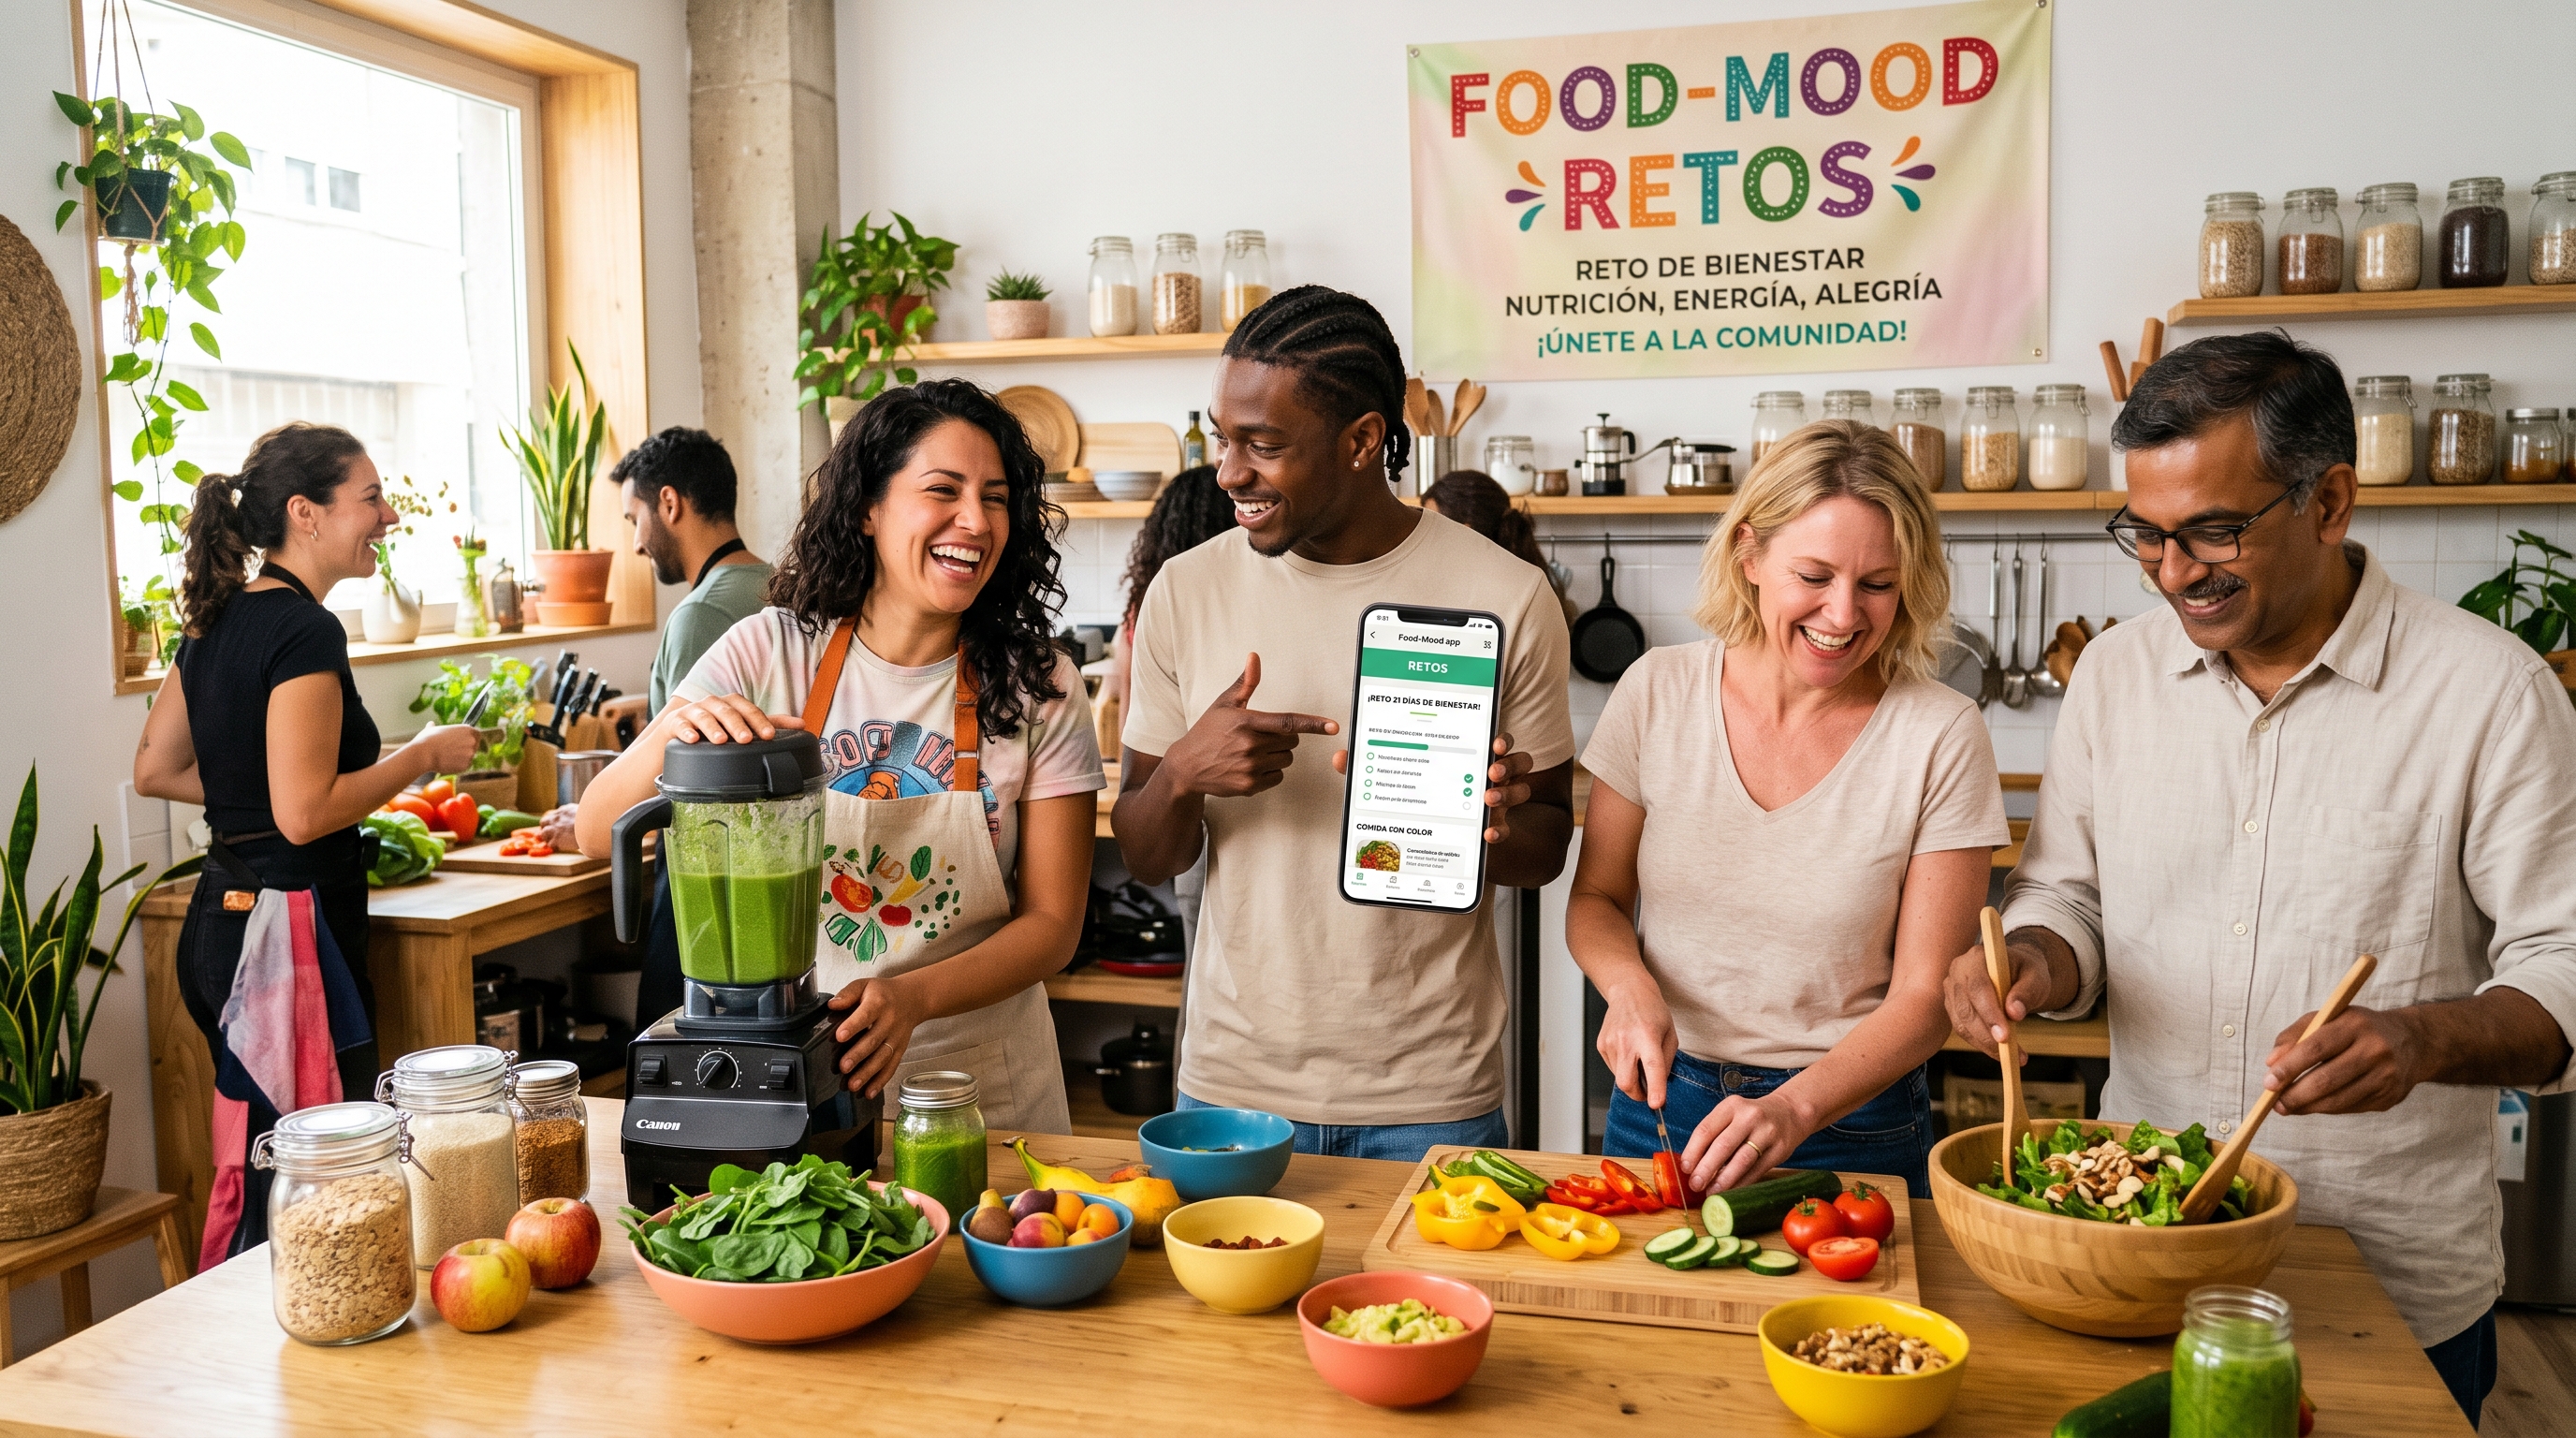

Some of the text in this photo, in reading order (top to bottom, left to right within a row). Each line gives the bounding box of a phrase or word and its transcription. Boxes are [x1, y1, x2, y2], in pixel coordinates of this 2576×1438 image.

[1450, 37, 1999, 138] FOOD-MOOD
[1564, 140, 1874, 231] RETOS
[1576, 247, 1865, 280] RETO DE BIENESTAR
[1505, 273, 1942, 316] NUTRICIÓN, ENERGÍA, ALEGRÍA
[1538, 320, 1907, 358] ¡ÚNETE A LA COMUNIDAD!
[1398, 634, 1461, 647] Food-Mood app
[1408, 660, 1448, 674] RETOS
[1368, 695, 1392, 703] ¡RETO
[1402, 696, 1421, 706] DÍAS
[1423, 698, 1433, 707] DE
[1435, 700, 1481, 711] BIENESTAR!
[1356, 823, 1387, 833] COMIDA
[1406, 828, 1433, 837] COLOR
[636, 1119, 681, 1131] Canon
